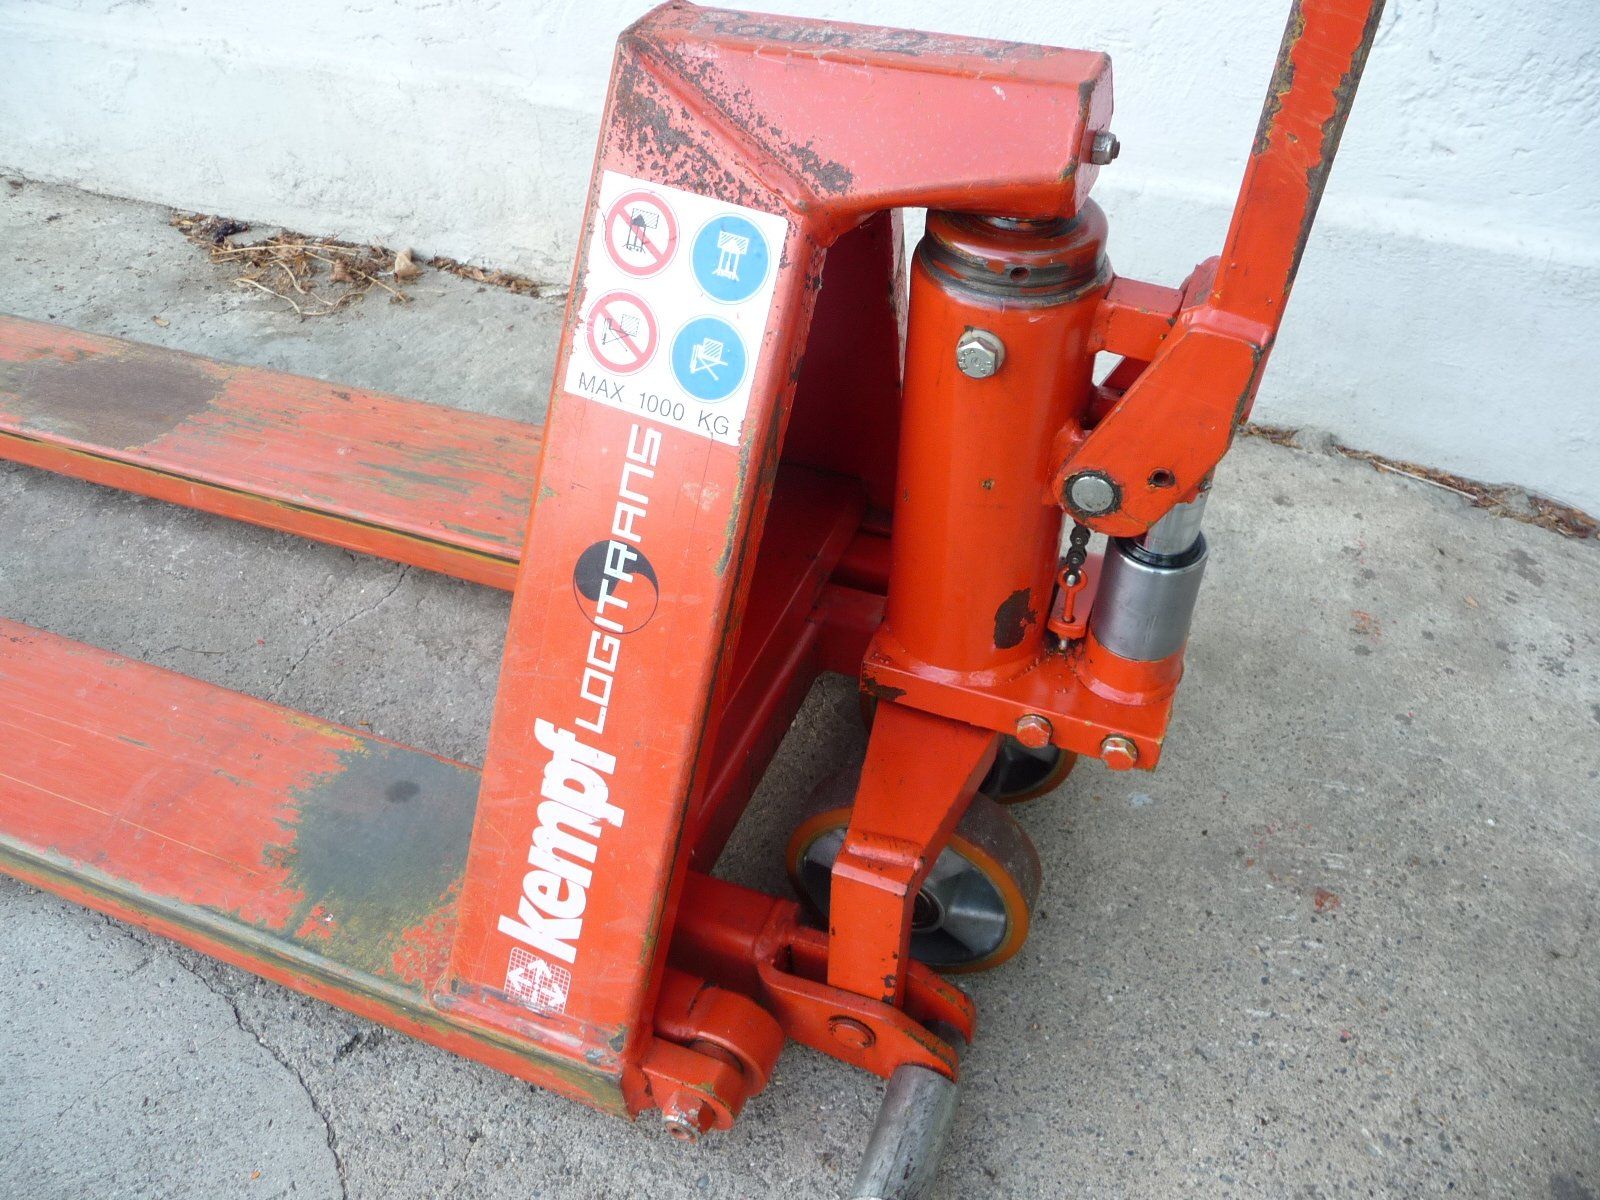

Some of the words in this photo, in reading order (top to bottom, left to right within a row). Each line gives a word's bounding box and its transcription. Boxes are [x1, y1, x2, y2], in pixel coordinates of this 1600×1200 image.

[578, 371, 625, 403] MAX
[639, 391, 685, 422] 1000
[697, 409, 730, 436] KG
[497, 717, 625, 964] kempf
[574, 423, 663, 735] LOGITRANS
